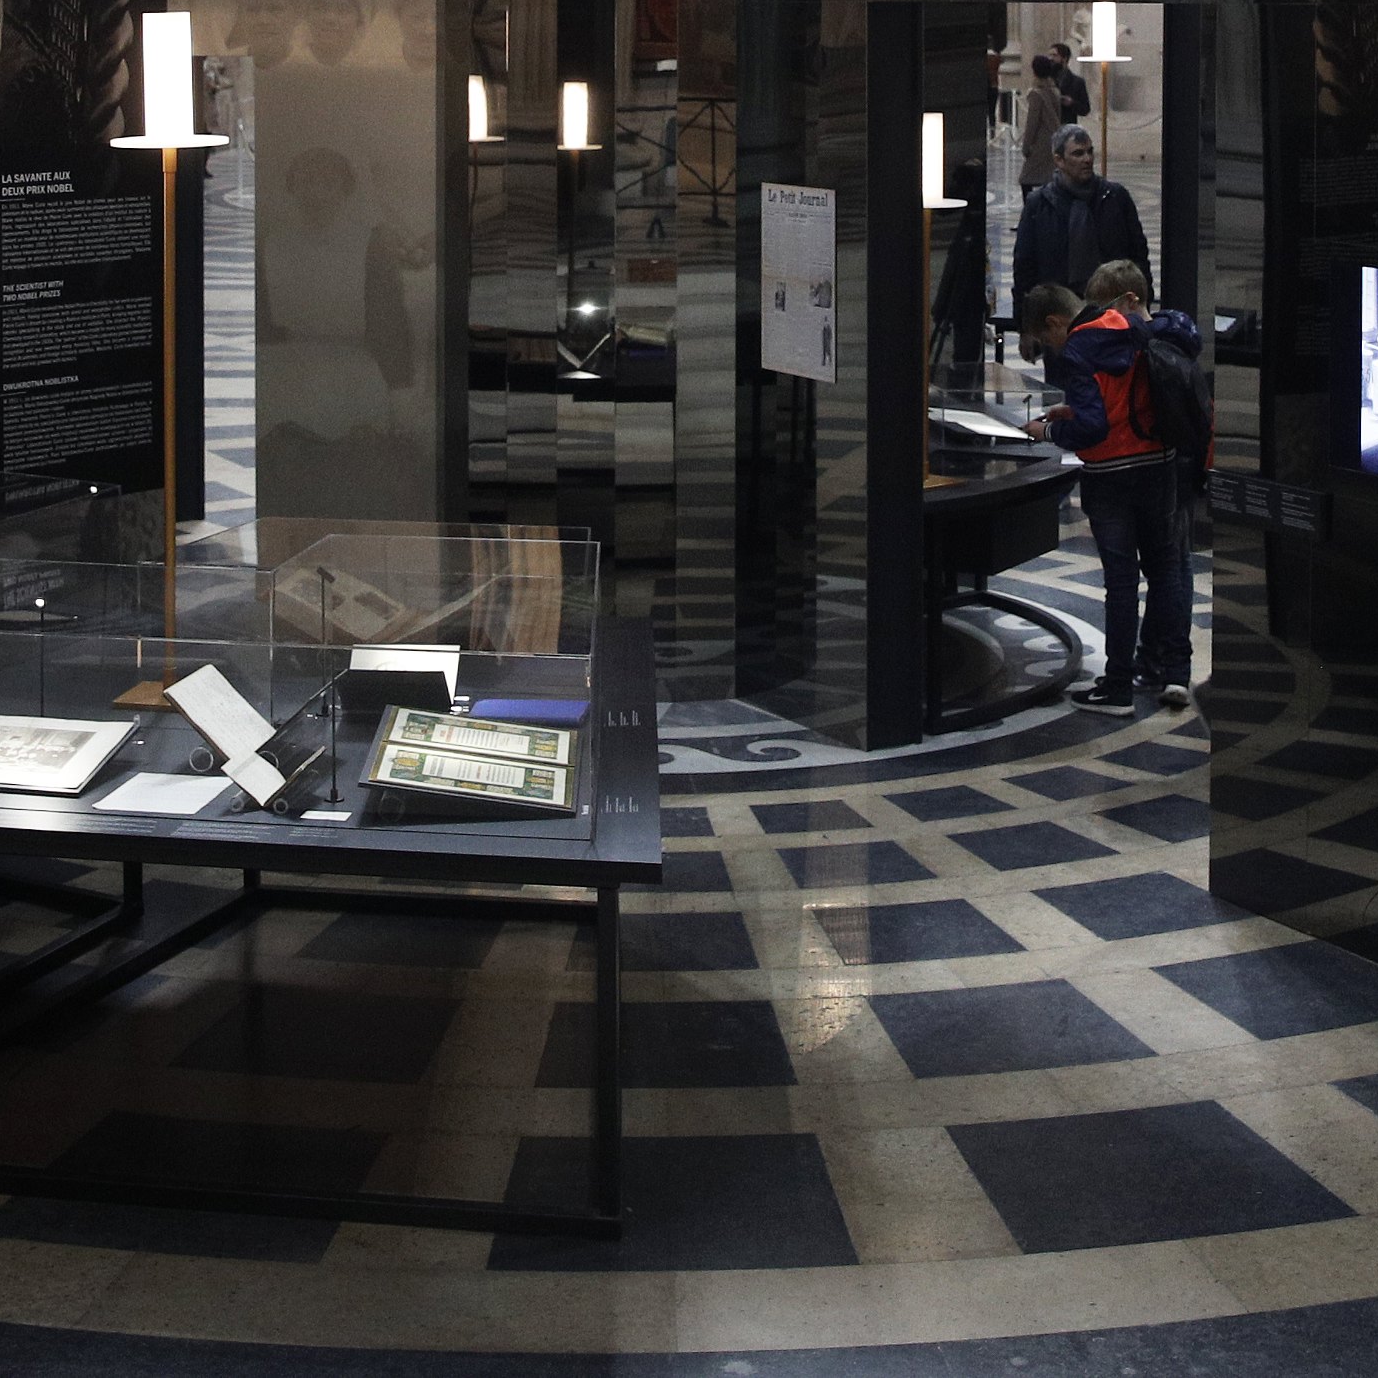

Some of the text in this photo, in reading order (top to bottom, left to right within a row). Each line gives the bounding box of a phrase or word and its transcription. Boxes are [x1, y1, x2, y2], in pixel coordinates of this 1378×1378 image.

[1, 171, 71, 184] LA SAVANTE AUX
[2, 183, 74, 197] DEUX PRIX NOBEL
